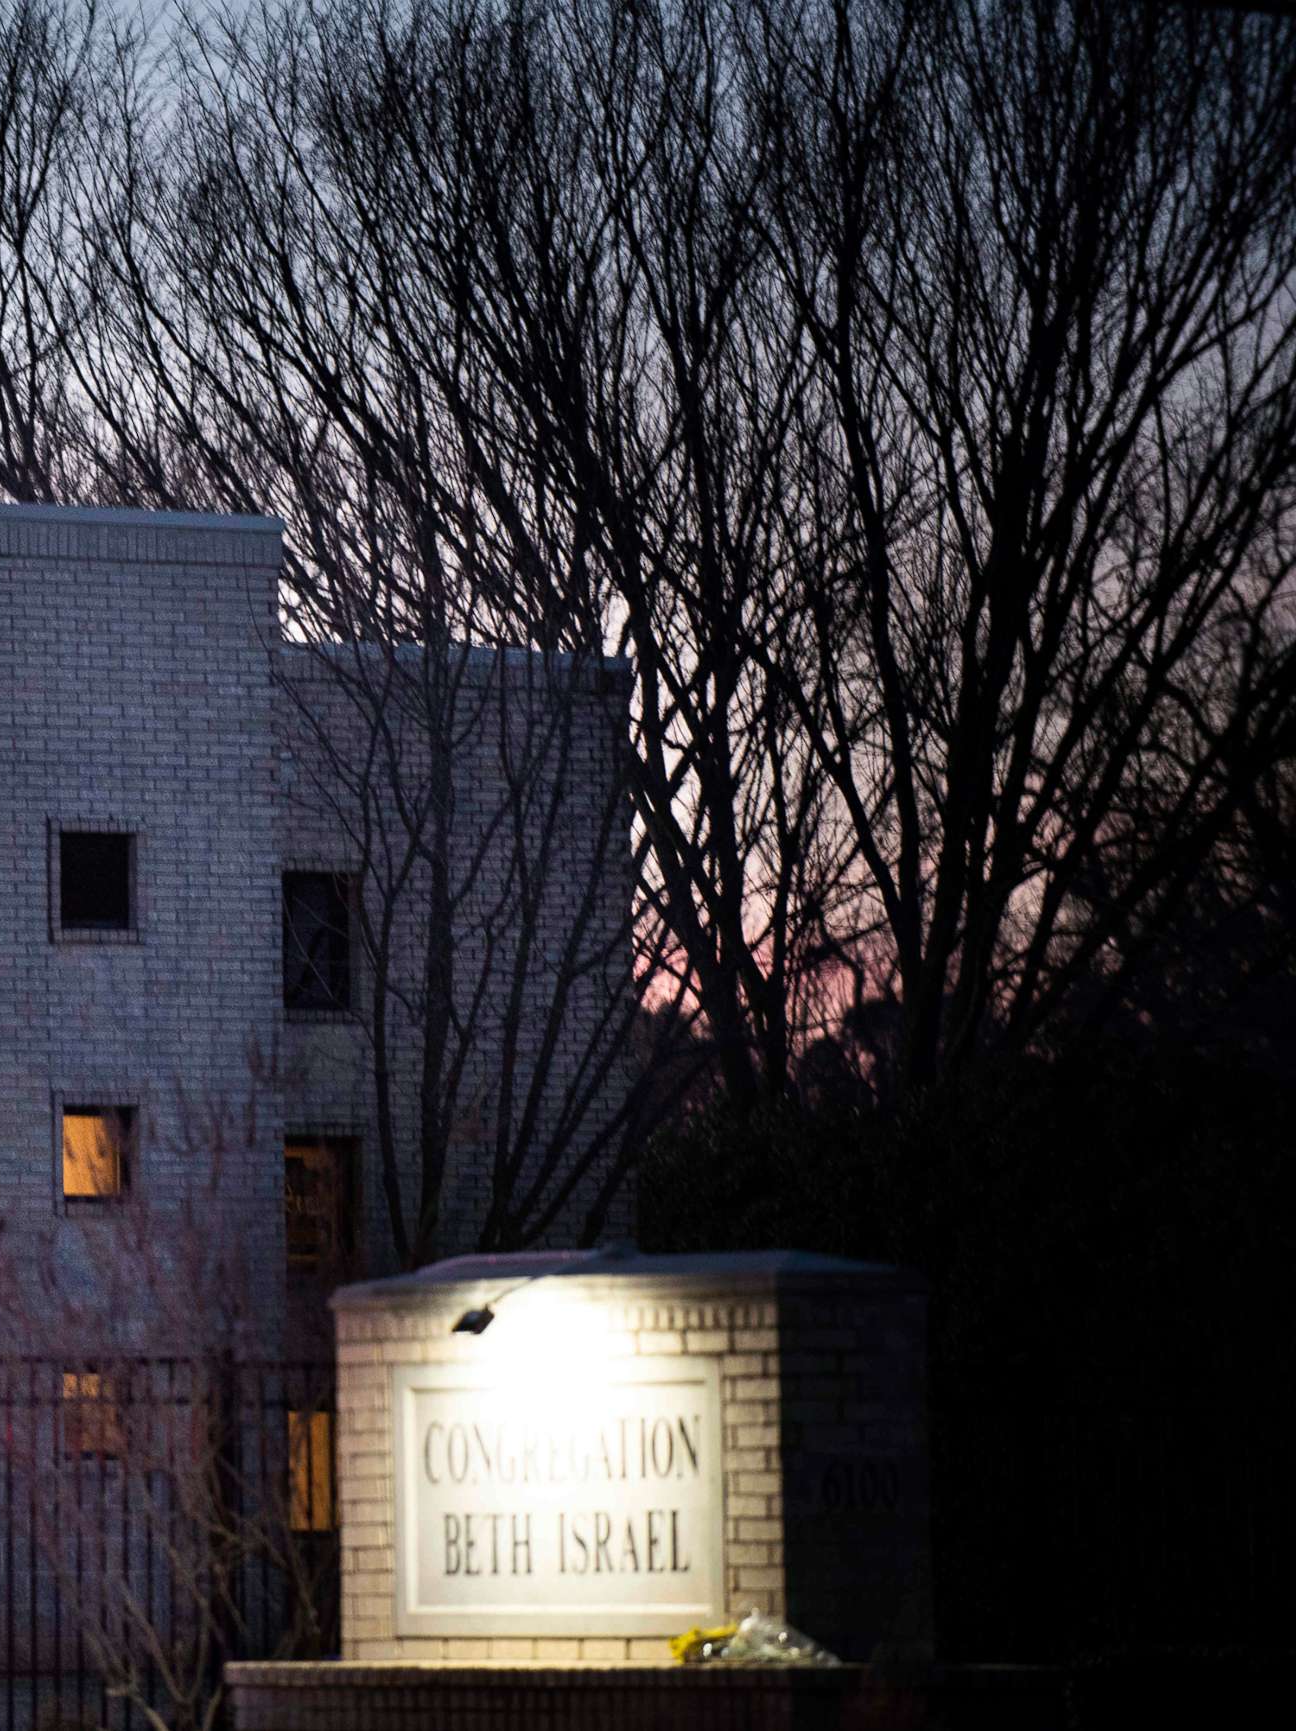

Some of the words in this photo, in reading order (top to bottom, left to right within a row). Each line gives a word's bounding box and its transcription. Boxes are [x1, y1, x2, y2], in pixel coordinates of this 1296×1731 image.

[424, 1415, 701, 1485] CONGREGATION
[443, 1512, 532, 1576] BETH
[559, 1509, 691, 1573] ISRAEL
